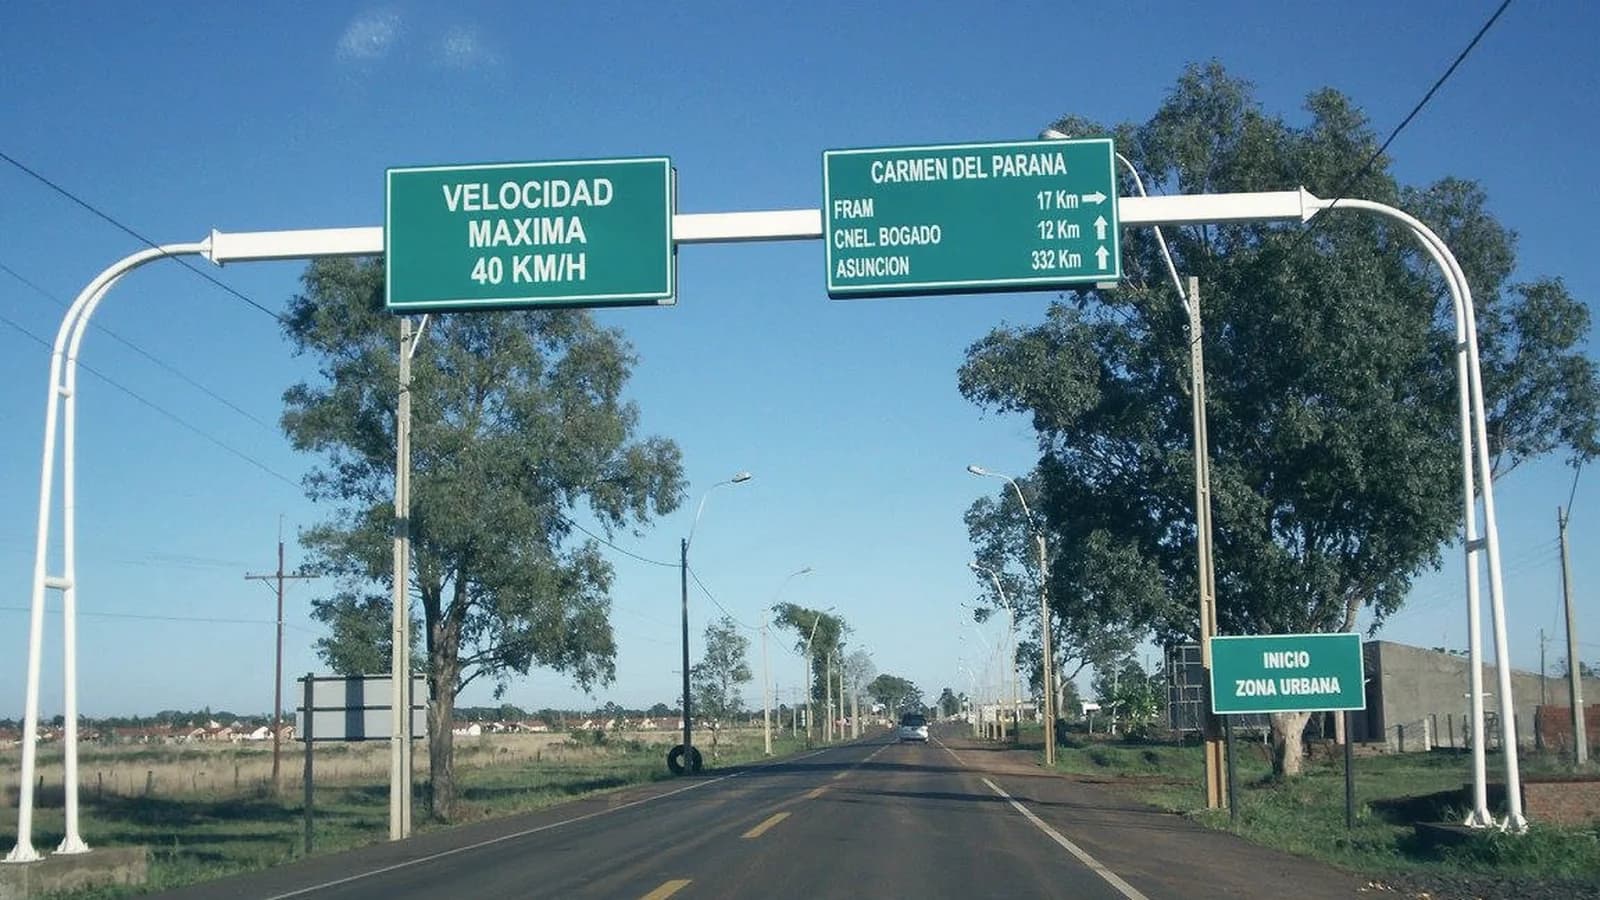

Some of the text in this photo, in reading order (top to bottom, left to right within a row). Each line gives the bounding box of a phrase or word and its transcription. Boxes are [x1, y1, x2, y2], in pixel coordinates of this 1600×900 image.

[871, 152, 1067, 184] CARMEN DEL PARANA
[442, 178, 614, 212] VELOCIDAD
[1037, 189, 1079, 210] 17 Km
[834, 199, 874, 219] FRAM
[468, 216, 587, 248] MAXIMA
[834, 225, 941, 249] CNEL. BOGADO
[1038, 219, 1080, 240] 12 Km
[471, 253, 586, 285] 40 KM/H
[836, 256, 910, 278] ASUNCION
[1031, 249, 1082, 270] 332 Km
[1263, 651, 1309, 668] INICIO
[1235, 677, 1341, 697] ZONA URBANA
